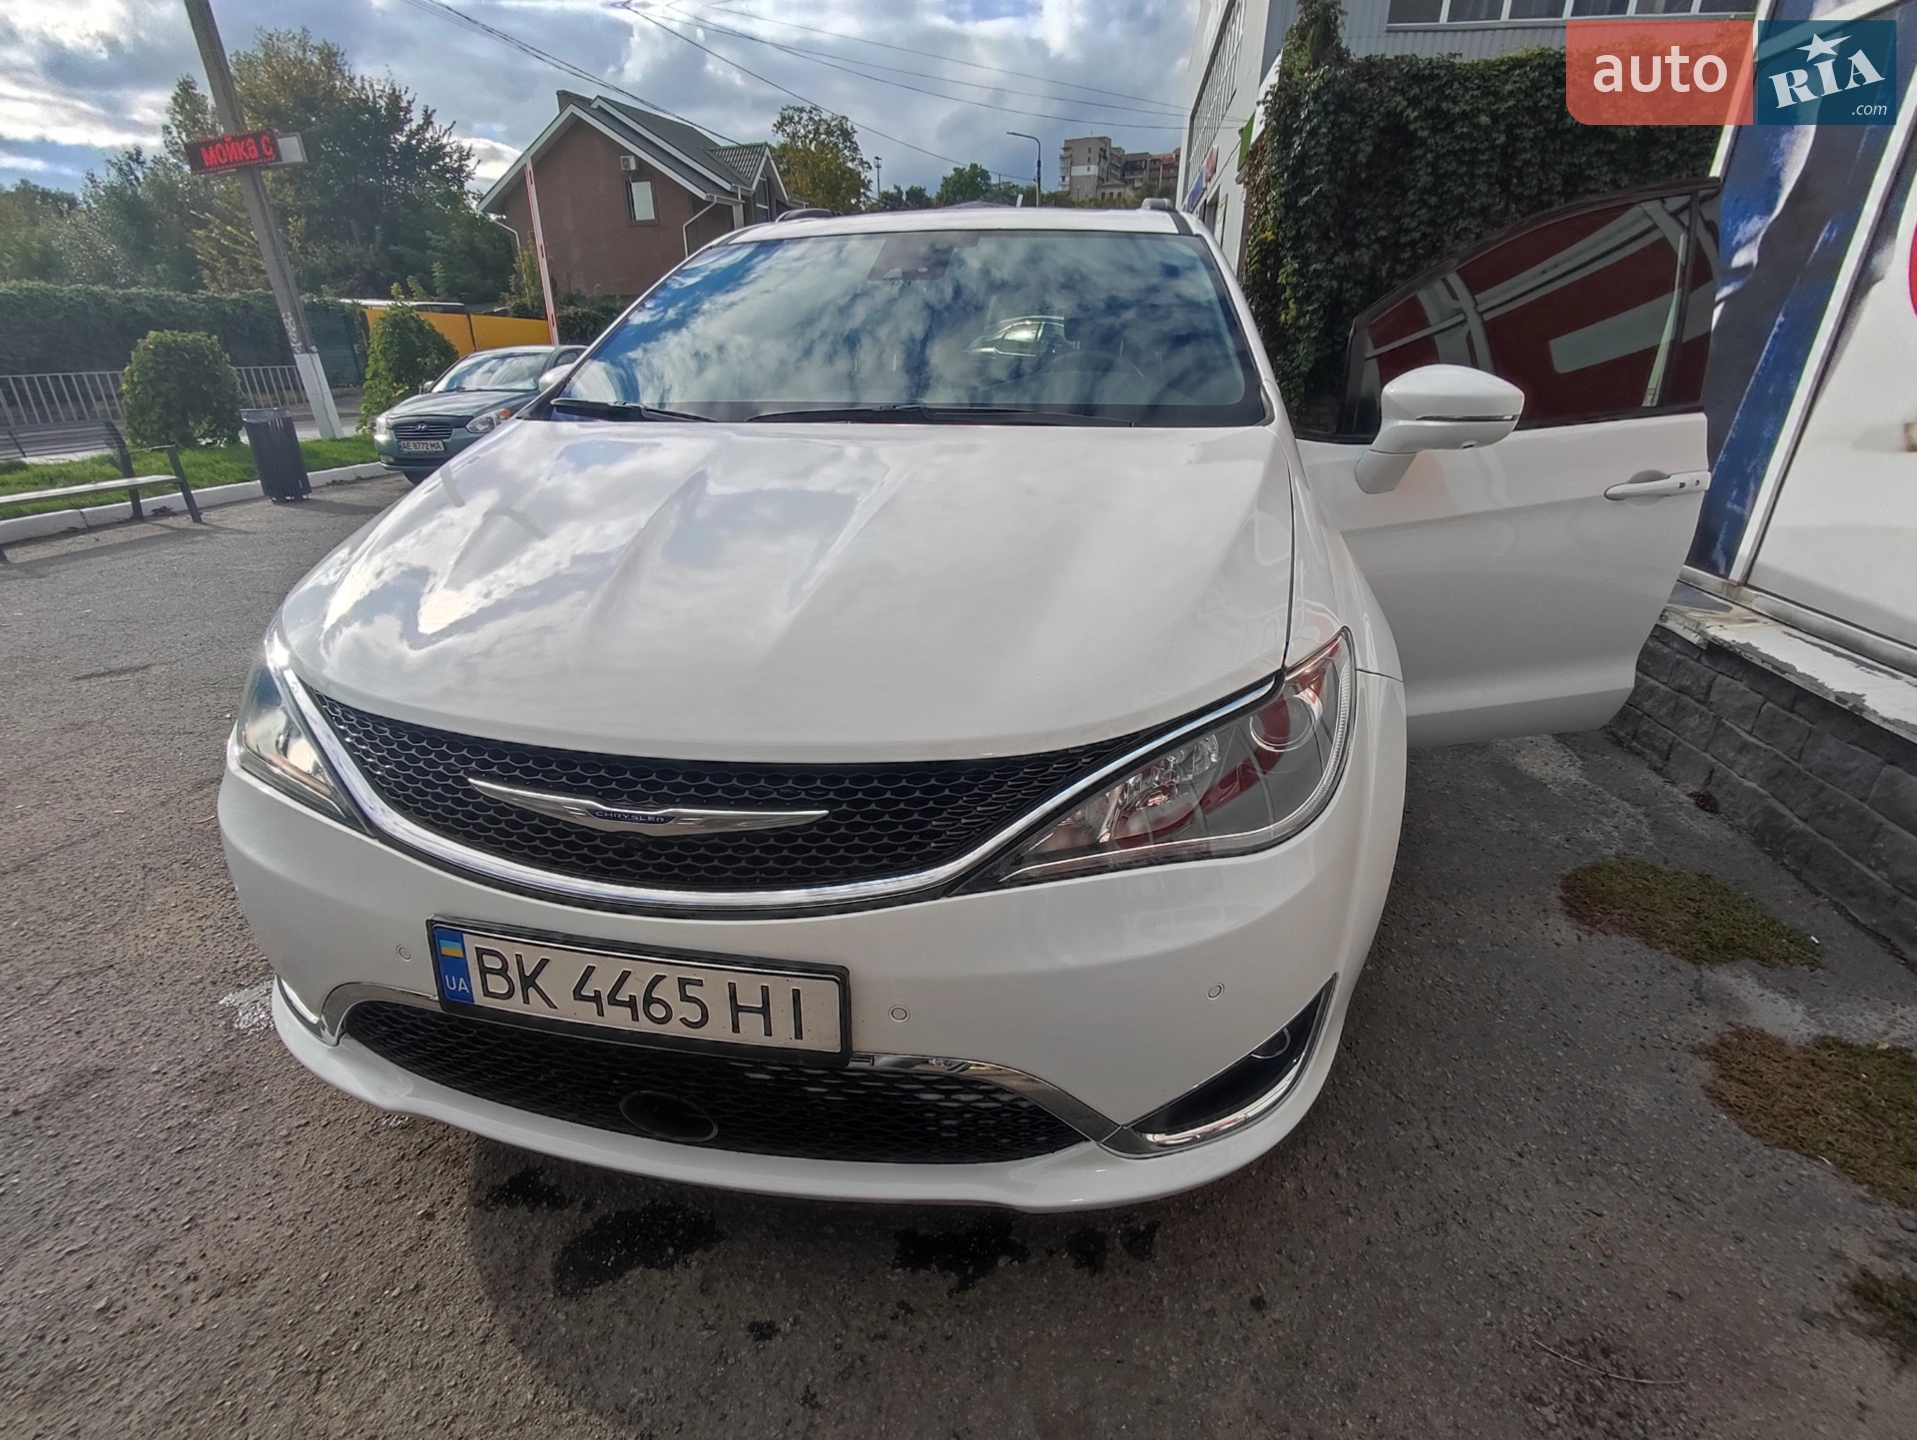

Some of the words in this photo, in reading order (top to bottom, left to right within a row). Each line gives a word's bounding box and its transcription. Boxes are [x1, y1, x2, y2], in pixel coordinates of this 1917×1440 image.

[595, 810, 665, 823] CHRYSLER
[445, 974, 471, 994] UA
[474, 945, 558, 1010] BK
[571, 964, 710, 1030] 4465
[727, 981, 804, 1041] HI
